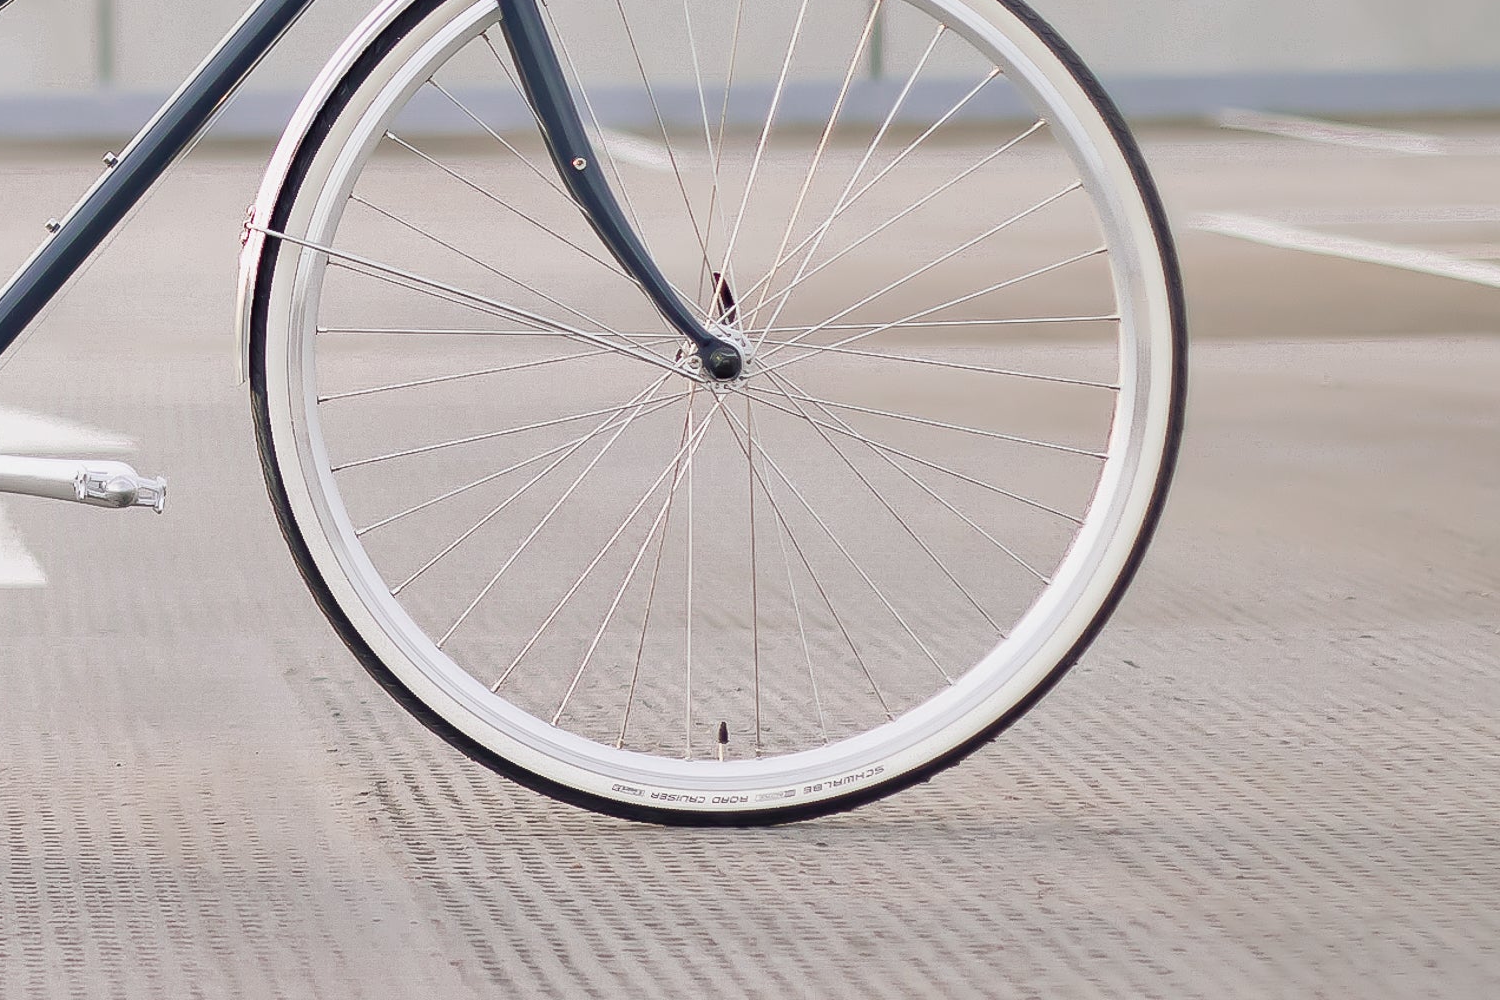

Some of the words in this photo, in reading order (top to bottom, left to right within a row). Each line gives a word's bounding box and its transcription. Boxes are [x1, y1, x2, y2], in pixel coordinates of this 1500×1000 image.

[803, 765, 885, 795] SCHWALBE
[650, 792, 706, 804] CRUISER
[711, 795, 749, 804] ROAD
